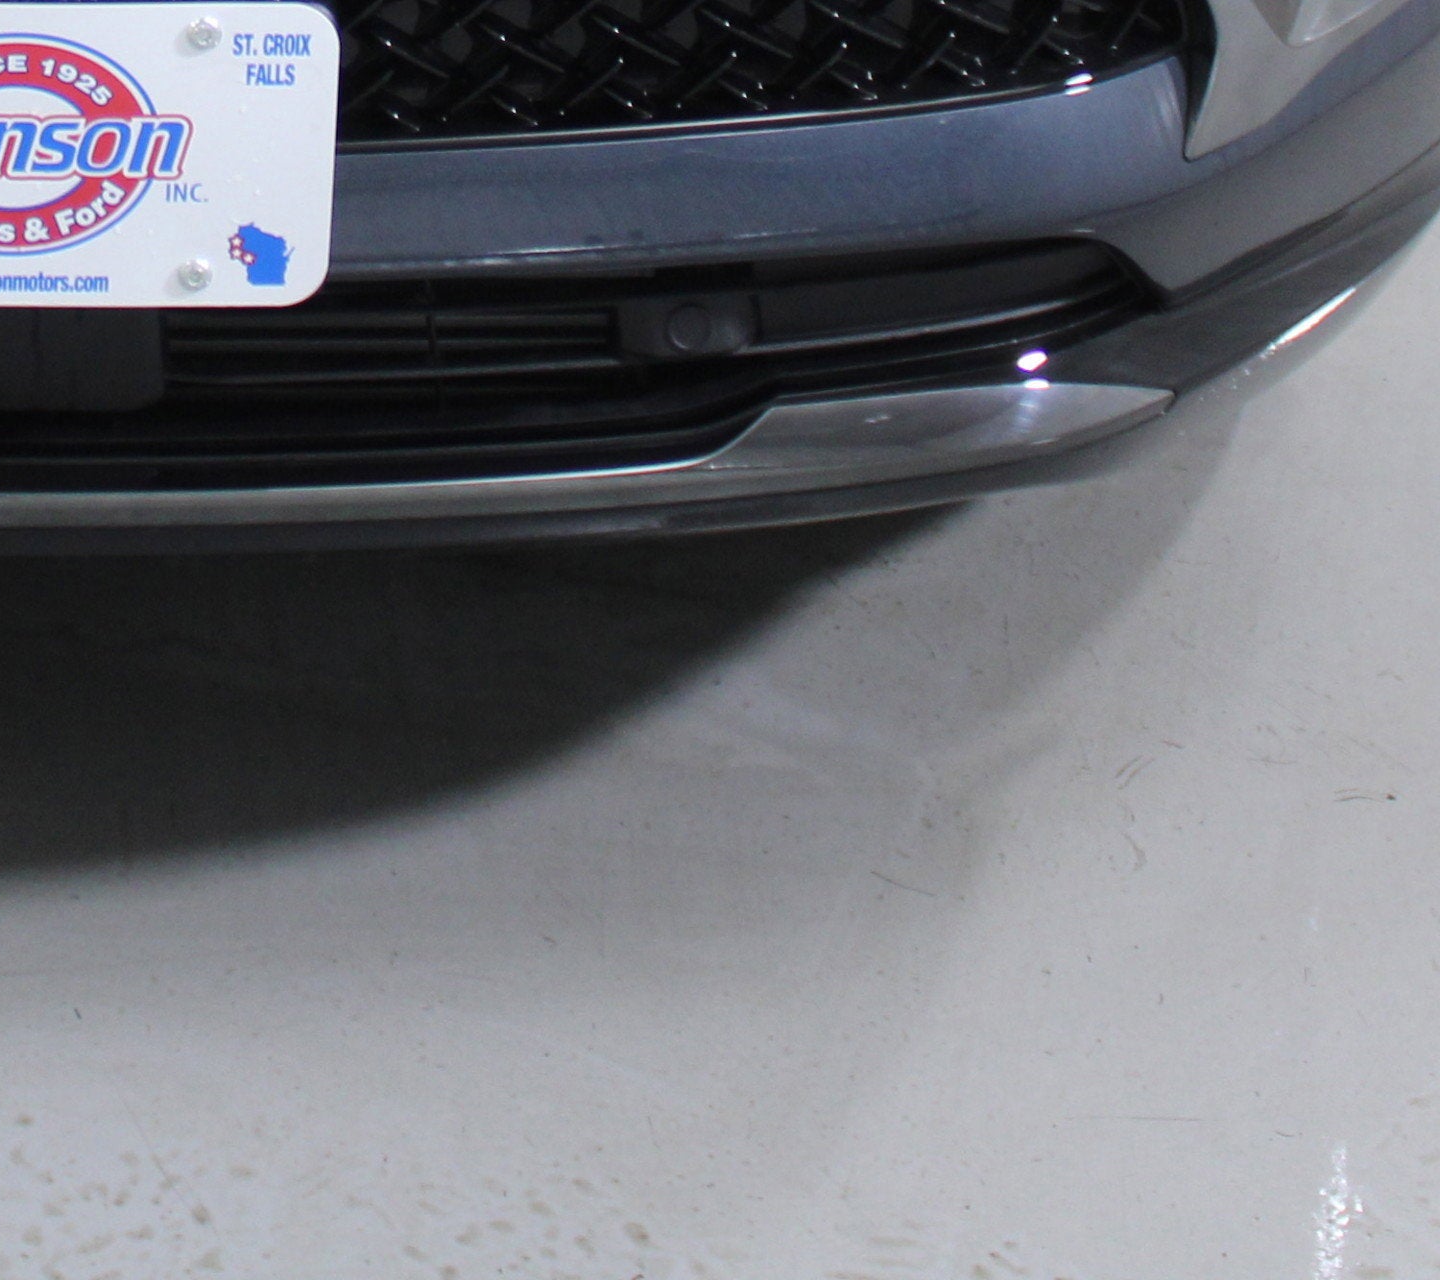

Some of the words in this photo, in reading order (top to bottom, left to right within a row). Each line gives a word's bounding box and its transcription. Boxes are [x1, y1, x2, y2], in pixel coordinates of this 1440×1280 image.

[232, 33, 258, 57] ST.
[262, 33, 312, 57] CROIX
[40, 57, 114, 107] 1925
[245, 63, 296, 87] FALLS
[165, 182, 209, 204] INC.
[24, 216, 51, 243] &
[55, 179, 126, 236] Ford
